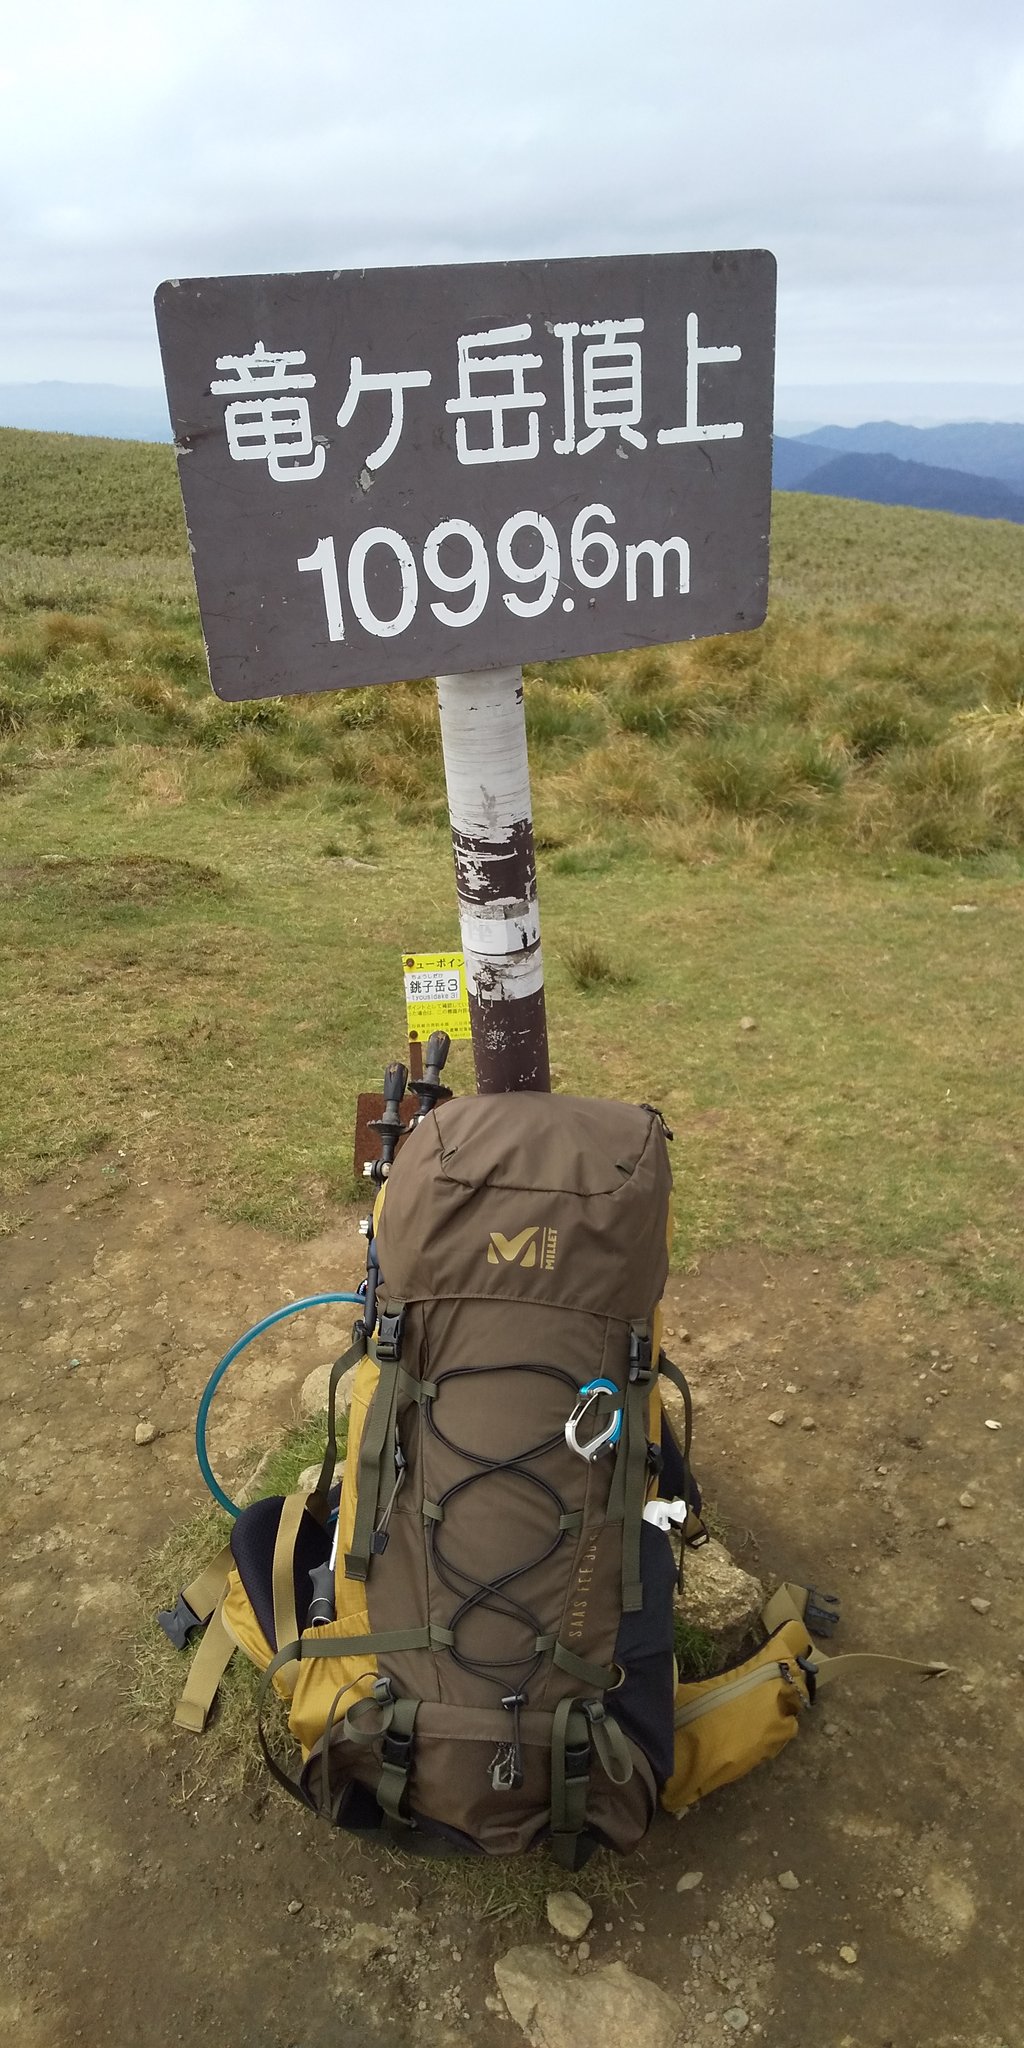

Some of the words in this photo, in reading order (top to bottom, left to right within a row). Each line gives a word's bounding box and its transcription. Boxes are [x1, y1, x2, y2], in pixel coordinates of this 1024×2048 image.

[298, 503, 691, 642] 1099.6m
[545, 1227, 558, 1270] MILLET
[569, 1601, 588, 1637] SAAS
